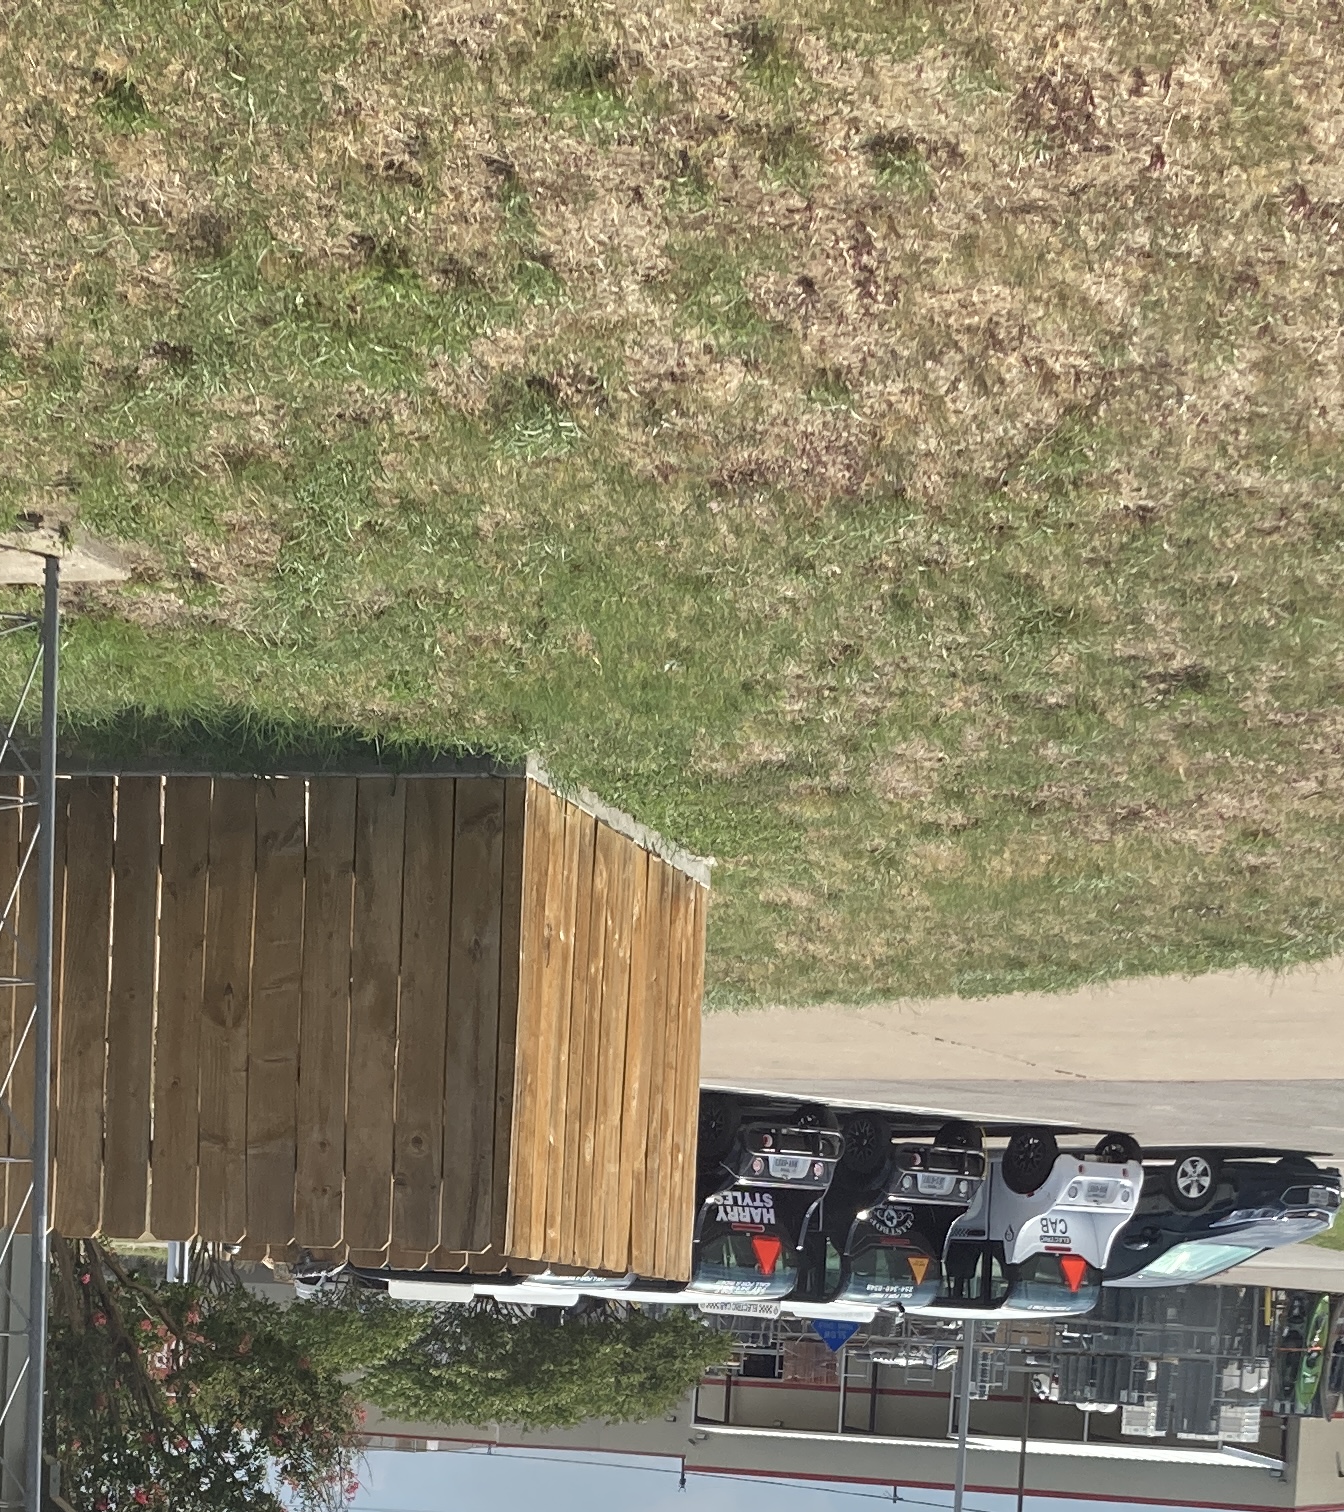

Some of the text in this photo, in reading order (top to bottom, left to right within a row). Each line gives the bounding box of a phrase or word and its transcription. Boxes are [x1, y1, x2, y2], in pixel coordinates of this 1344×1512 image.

[712, 1190, 773, 1207] STYLES
[716, 1206, 776, 1224] HARRY
[1040, 1218, 1068, 1234] CAB
[732, 1303, 758, 1313] ELECTRIC
